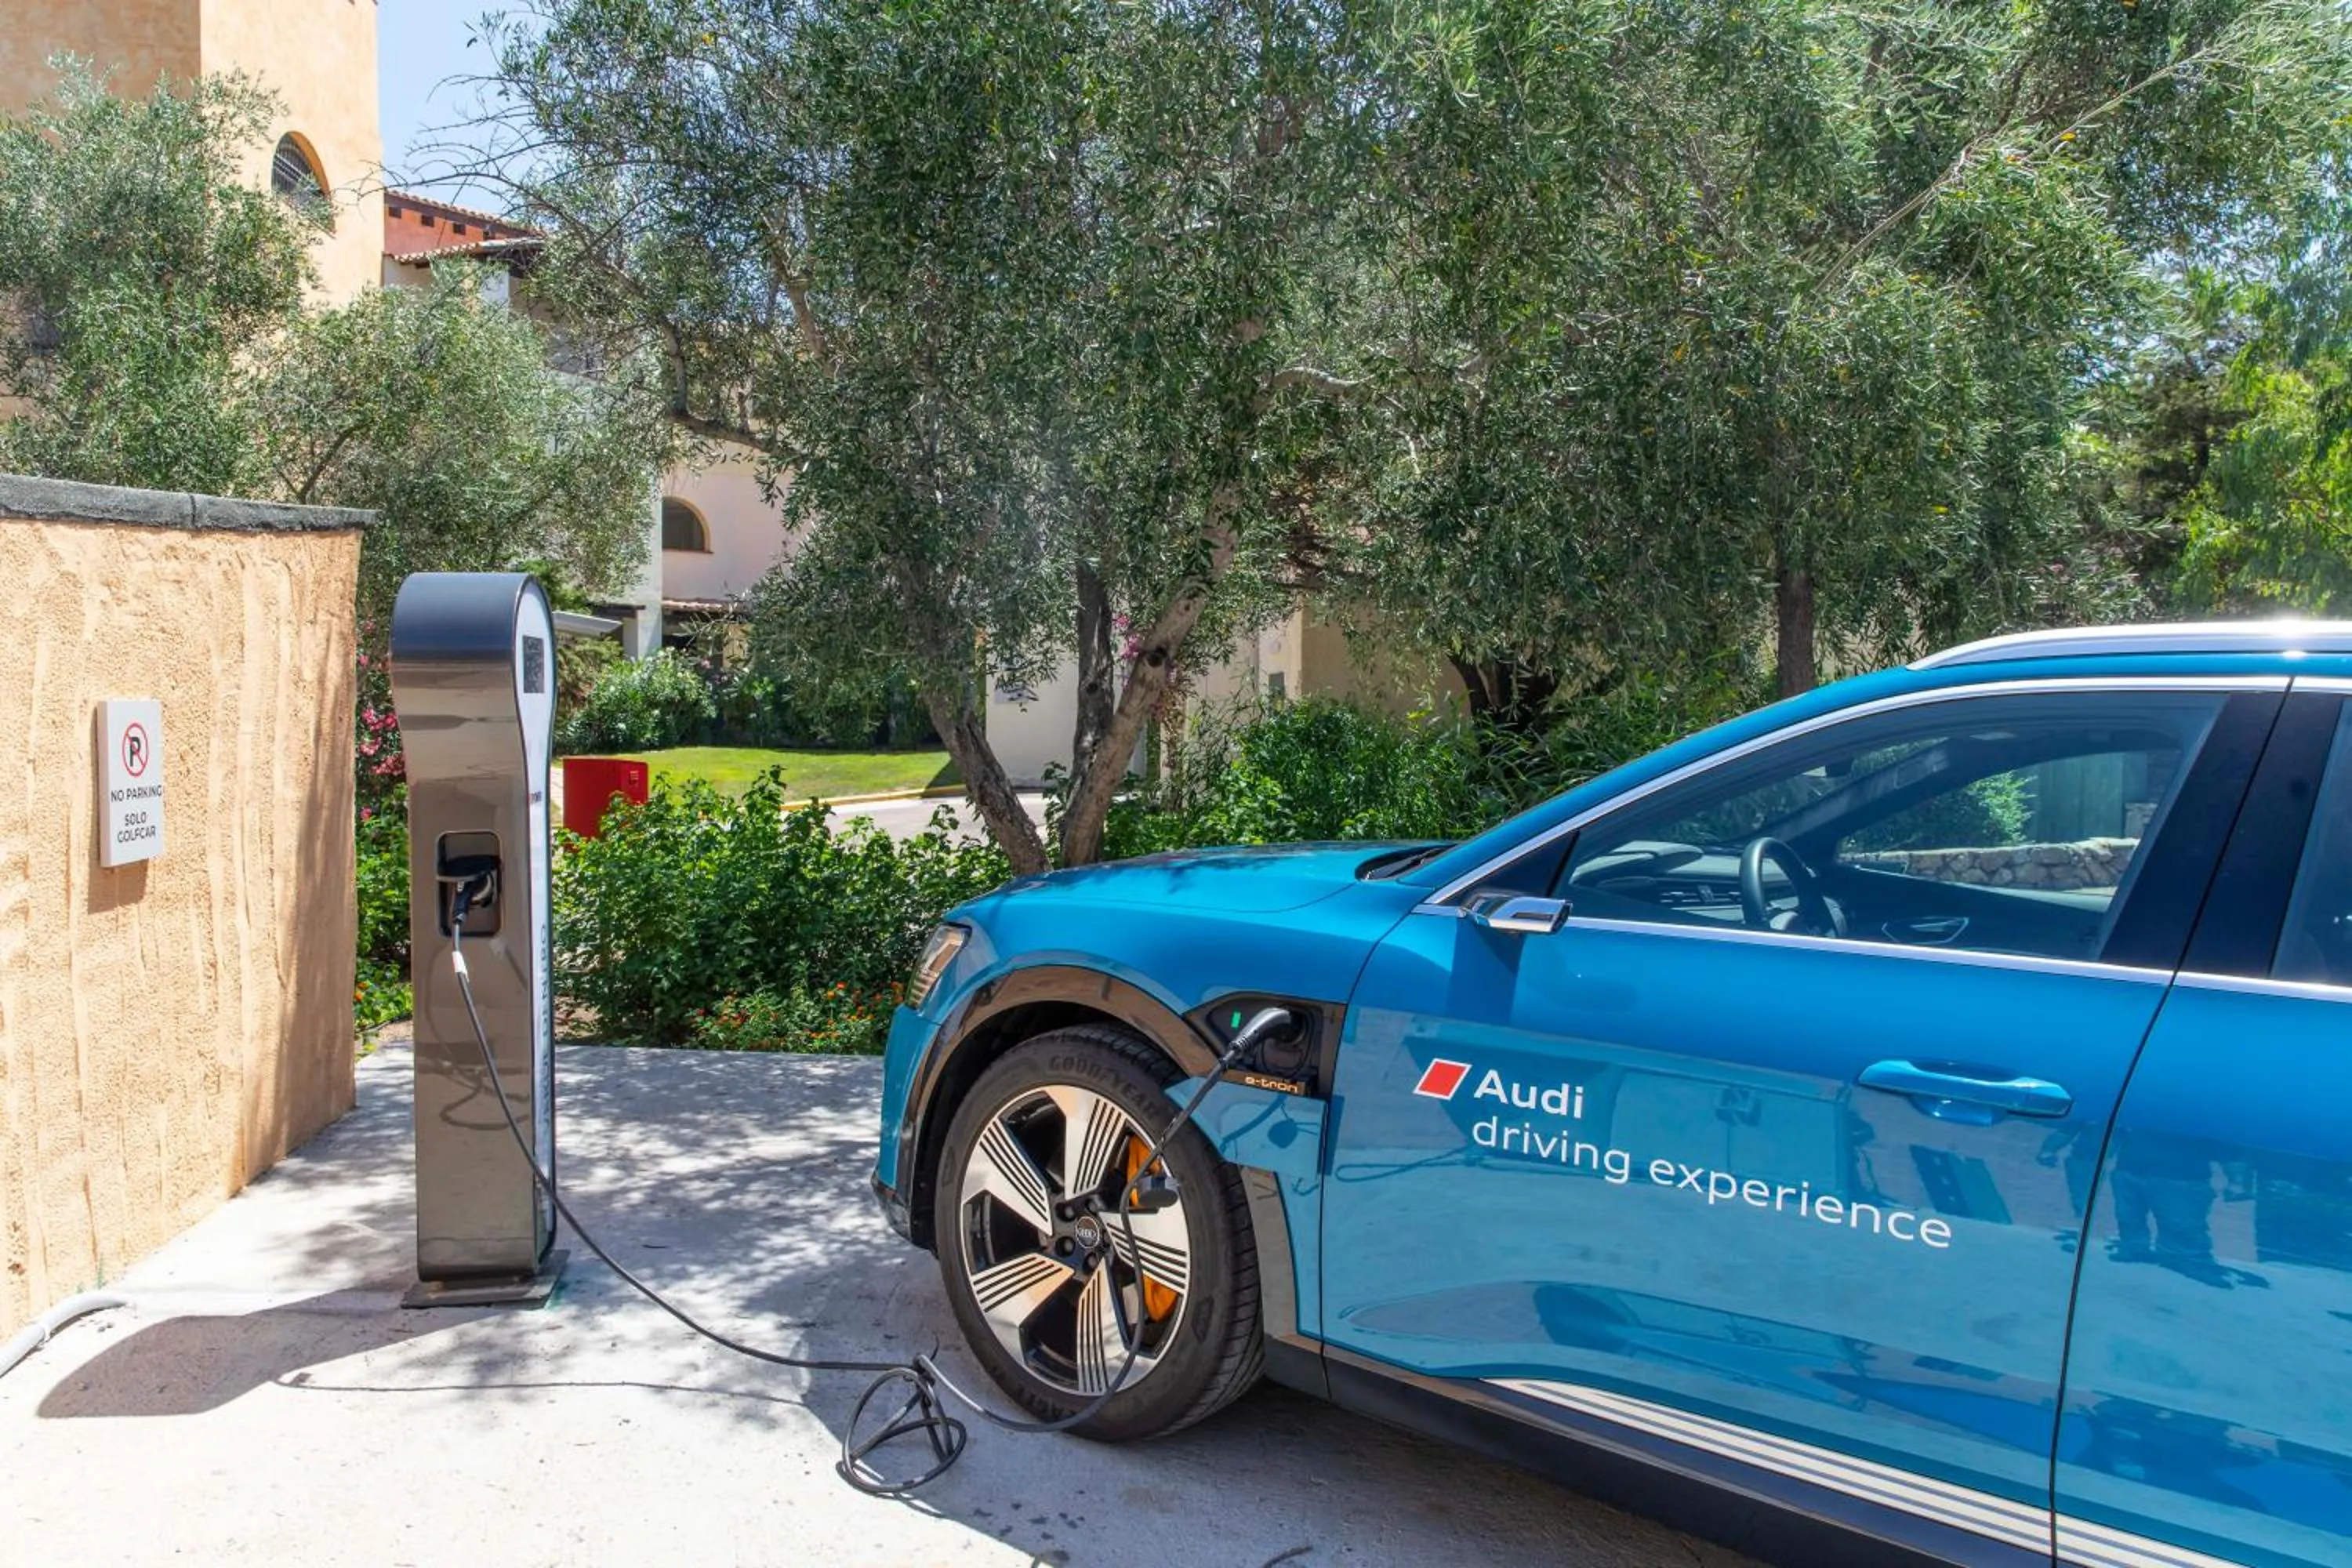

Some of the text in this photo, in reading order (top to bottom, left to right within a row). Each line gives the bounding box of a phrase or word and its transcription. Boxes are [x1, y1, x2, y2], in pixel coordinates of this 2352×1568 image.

[111, 785, 162, 803] NO PARKING
[125, 811, 147, 826] SOLO
[118, 826, 156, 843] GOLFCAR
[1245, 1076, 1298, 1093] e-tron
[1473, 1069, 1584, 1119] Audi
[1472, 1117, 1952, 1248] driving experience
